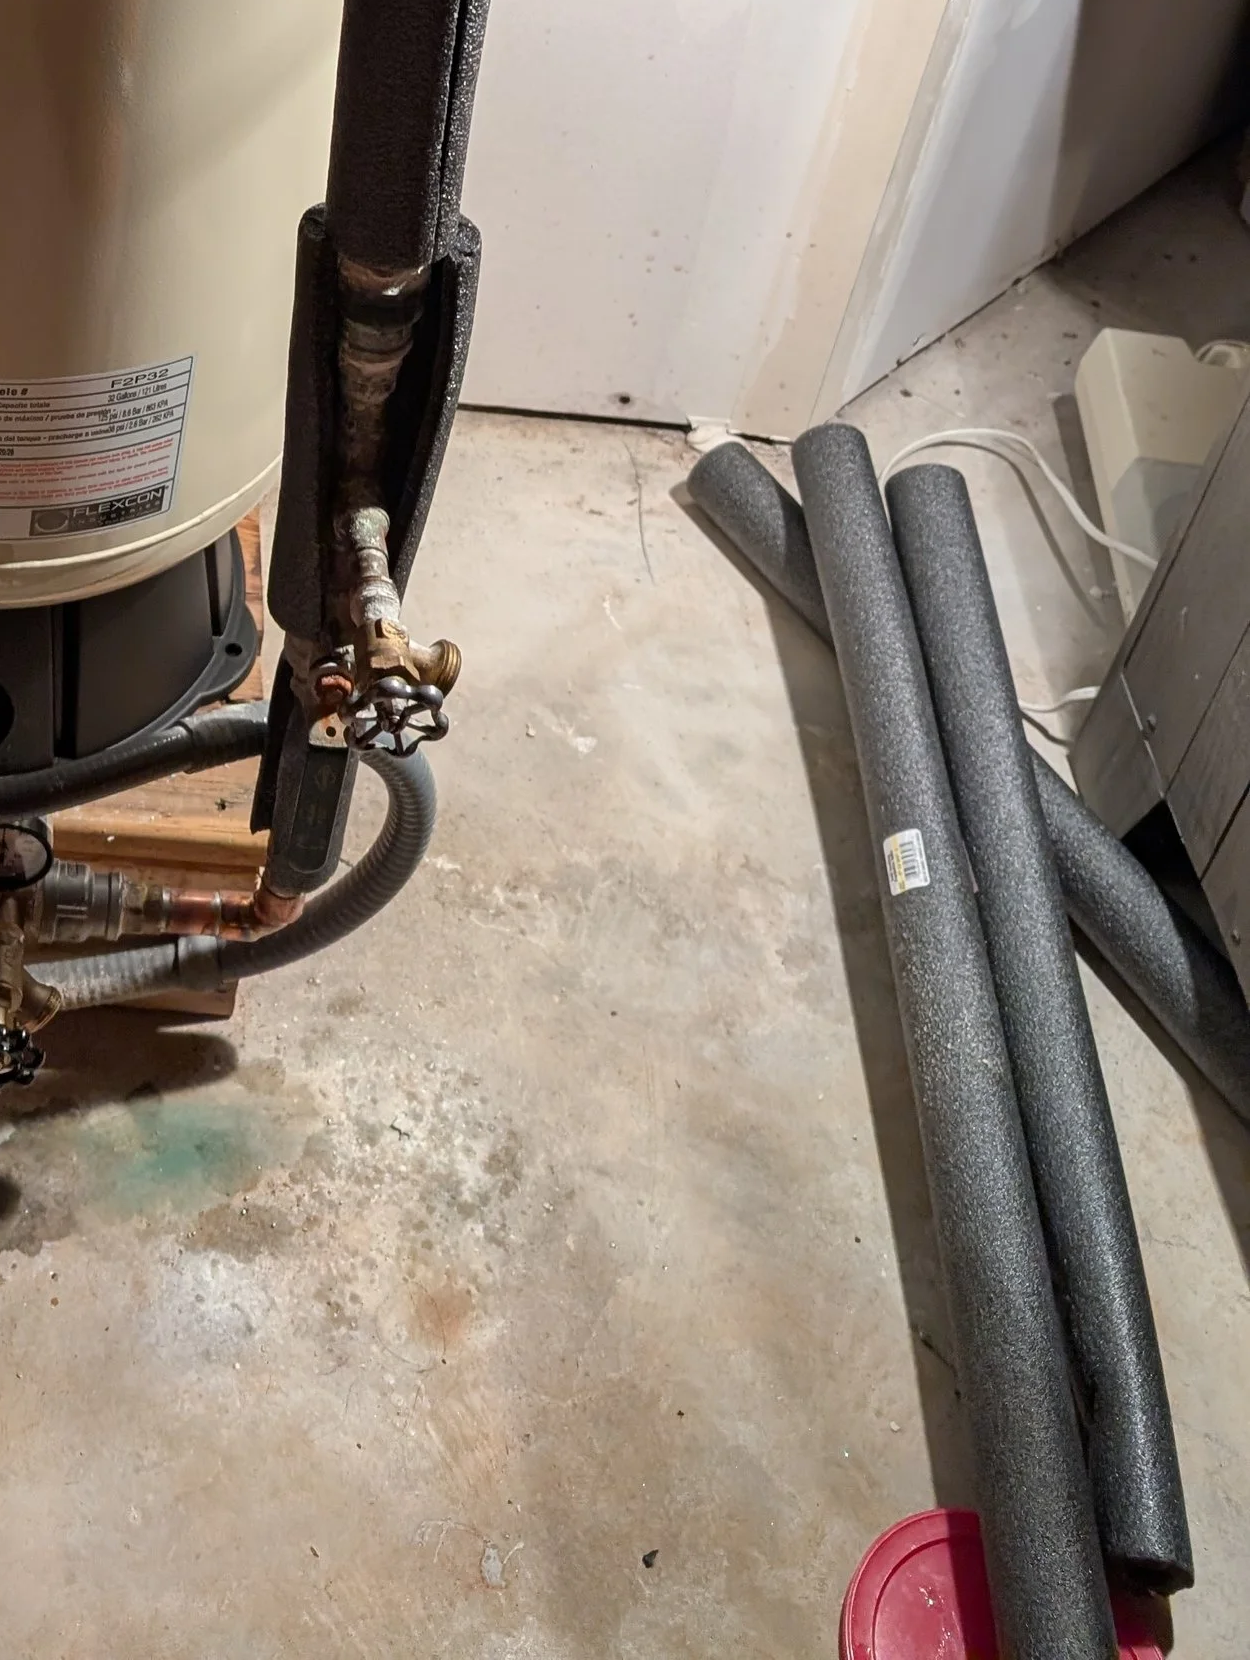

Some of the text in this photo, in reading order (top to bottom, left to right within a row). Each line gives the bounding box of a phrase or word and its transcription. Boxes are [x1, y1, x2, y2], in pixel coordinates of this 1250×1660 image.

[110, 368, 170, 389] F2P32
[20, 387, 29, 396] #
[107, 394, 116, 403] 32
[116, 391, 137, 401] Gallons
[142, 386, 151, 396] 121
[152, 382, 167, 393] Litres
[29, 401, 50, 409] totale
[132, 406, 142, 416] Bar
[156, 399, 169, 409] KPA
[3, 413, 13, 422] de
[51, 413, 75, 423] prueba
[116, 423, 125, 434] psi
[138, 418, 148, 428] Bar
[163, 409, 175, 420] KPA
[3, 433, 15, 442] del
[16, 434, 42, 444] tanque
[72, 491, 162, 518] FLEXCON
